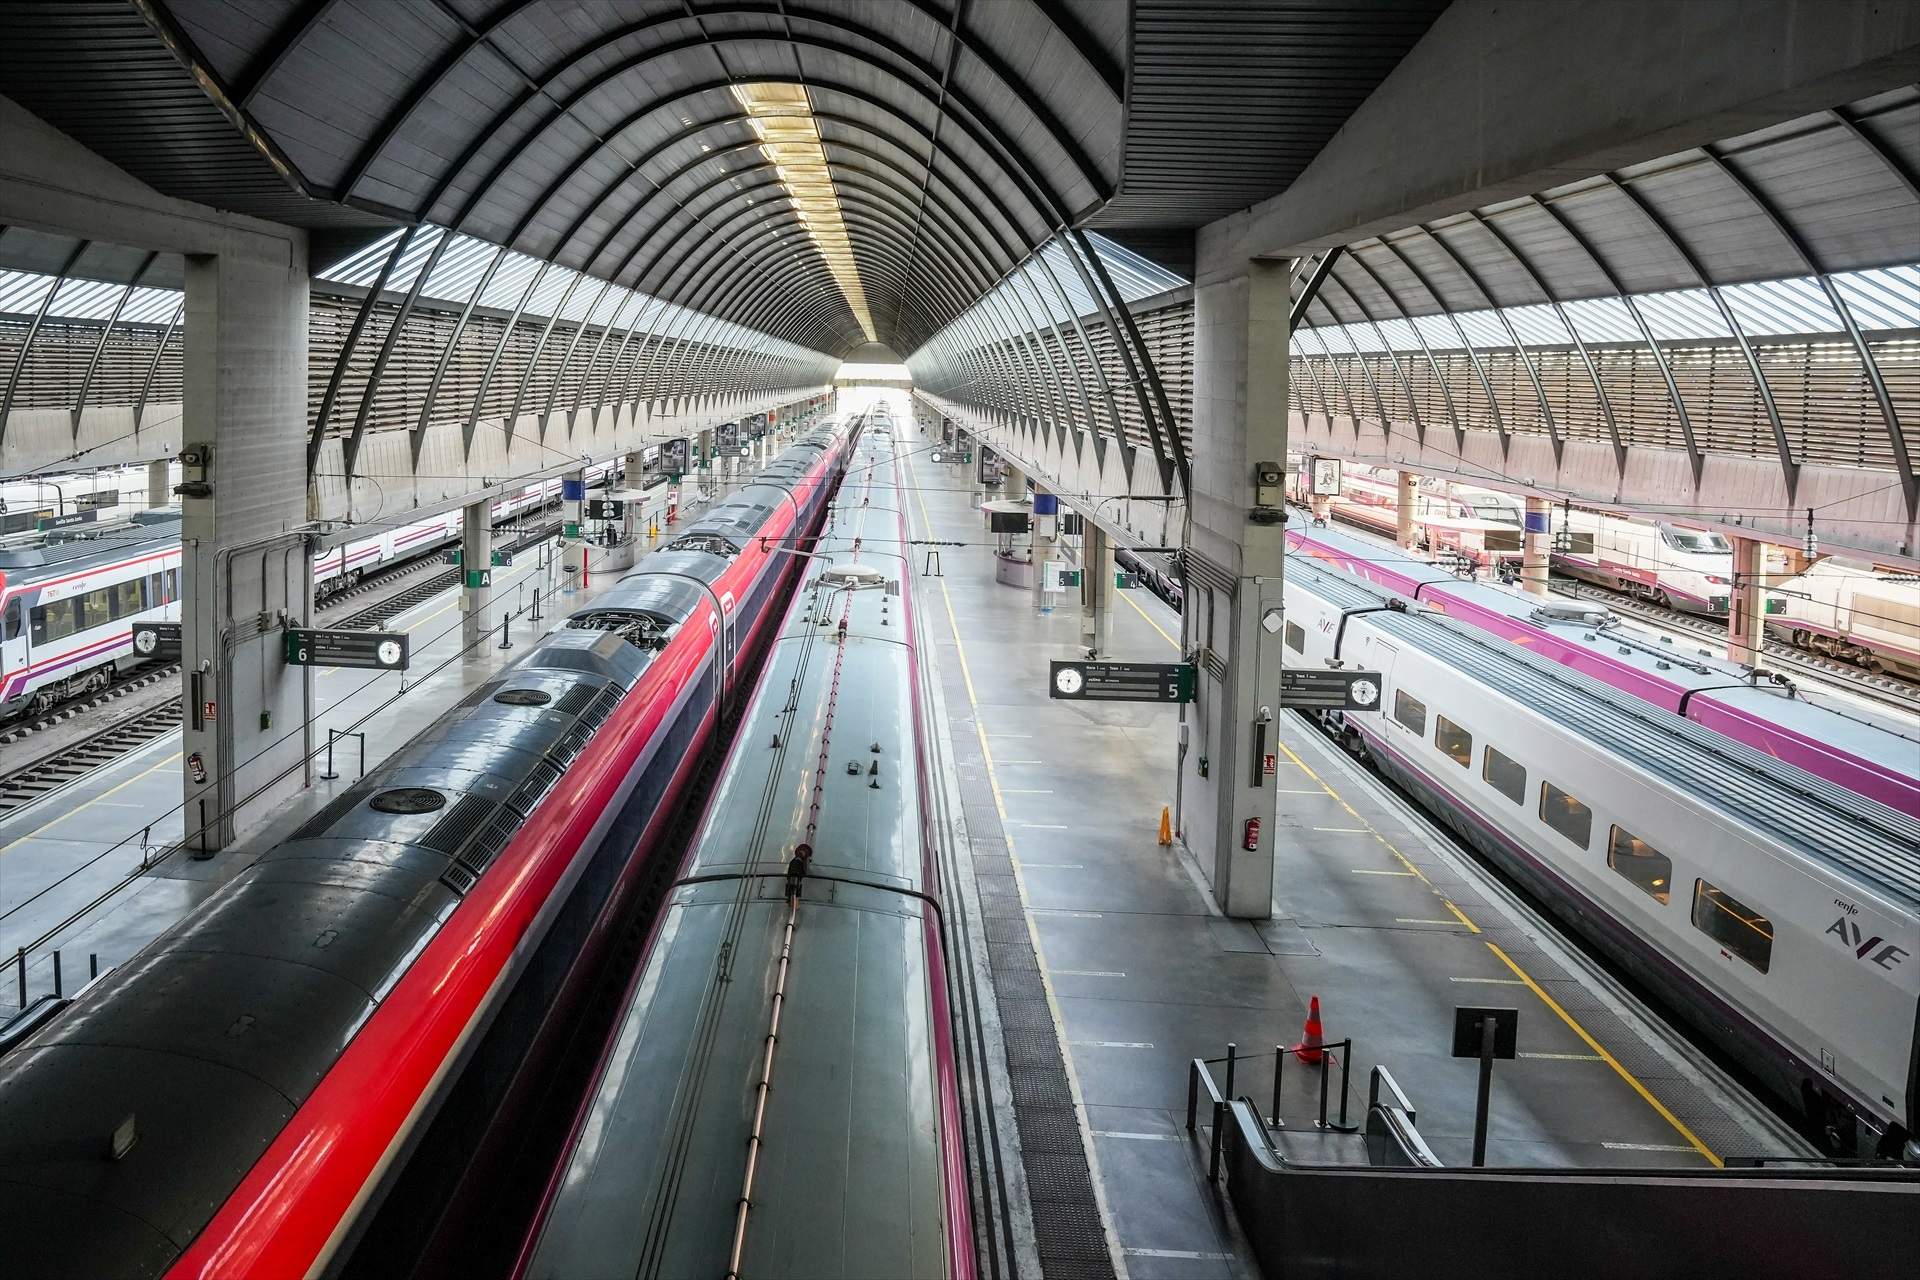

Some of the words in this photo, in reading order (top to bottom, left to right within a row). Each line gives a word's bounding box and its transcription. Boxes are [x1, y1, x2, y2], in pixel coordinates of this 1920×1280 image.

[481, 572, 490, 585] A
[298, 648, 307, 661] 6
[1168, 684, 1178, 698] 5
[1834, 898, 1859, 916] renfe
[1825, 916, 1910, 971] AVE
